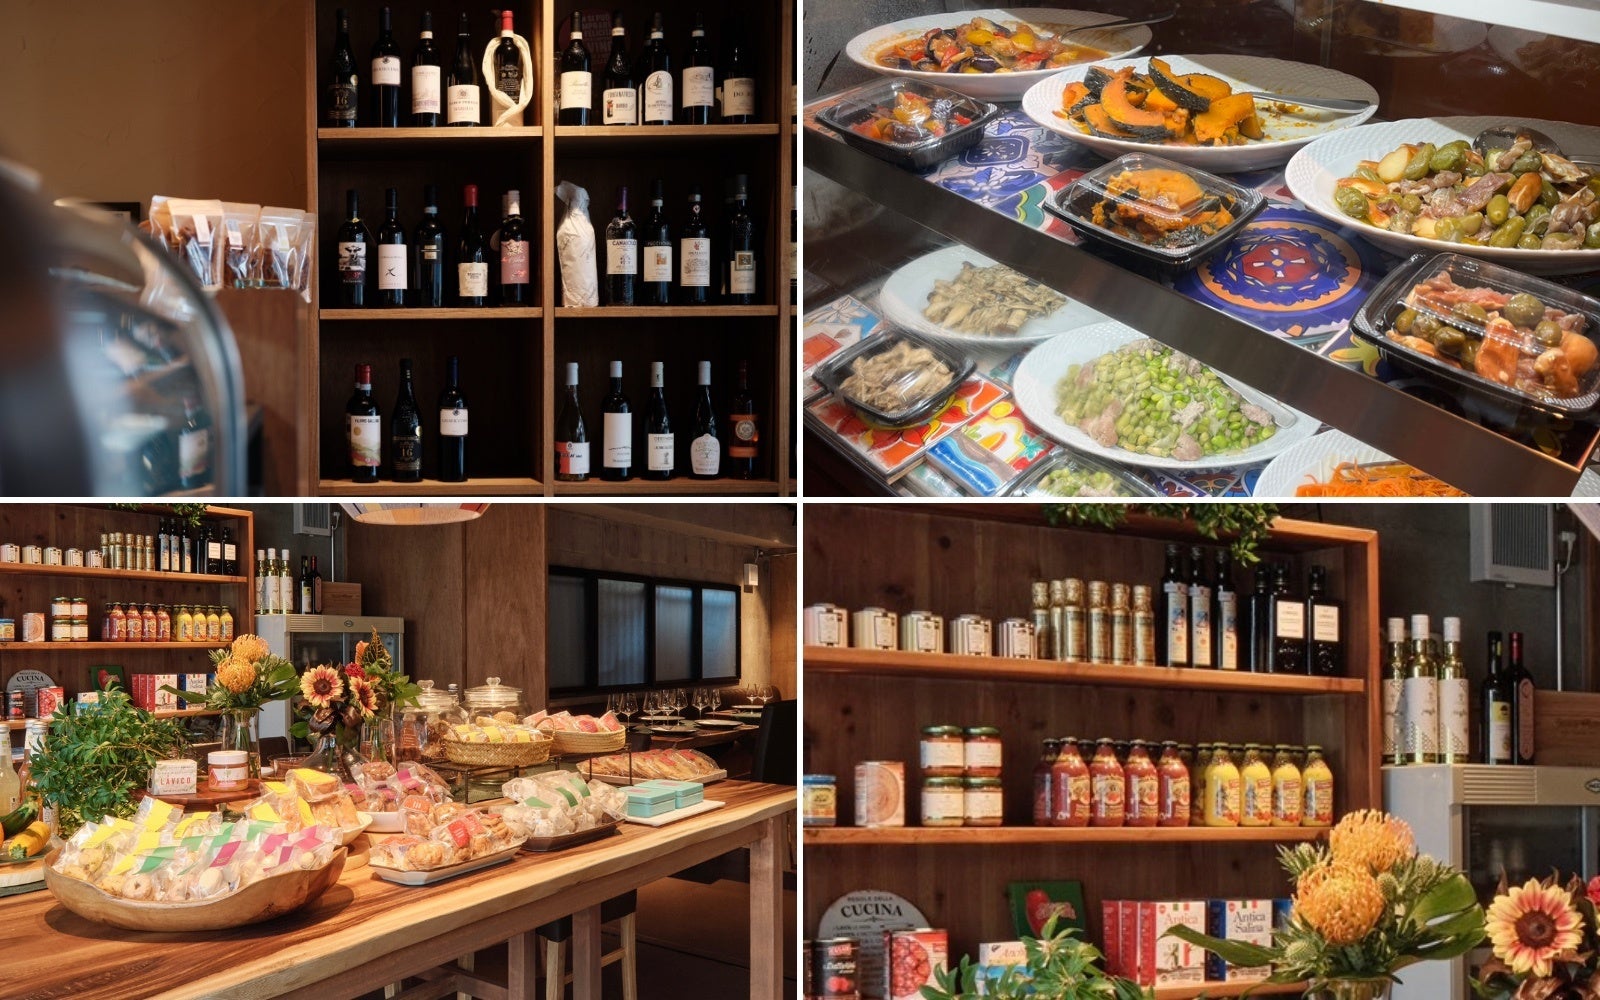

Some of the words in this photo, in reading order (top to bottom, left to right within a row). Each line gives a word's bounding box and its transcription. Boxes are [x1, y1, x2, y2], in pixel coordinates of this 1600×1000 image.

[840, 903, 903, 918] CUCINA
[1164, 913, 1198, 924] Antica
[1232, 911, 1266, 922] Antica
[1234, 922, 1264, 933] Salina
